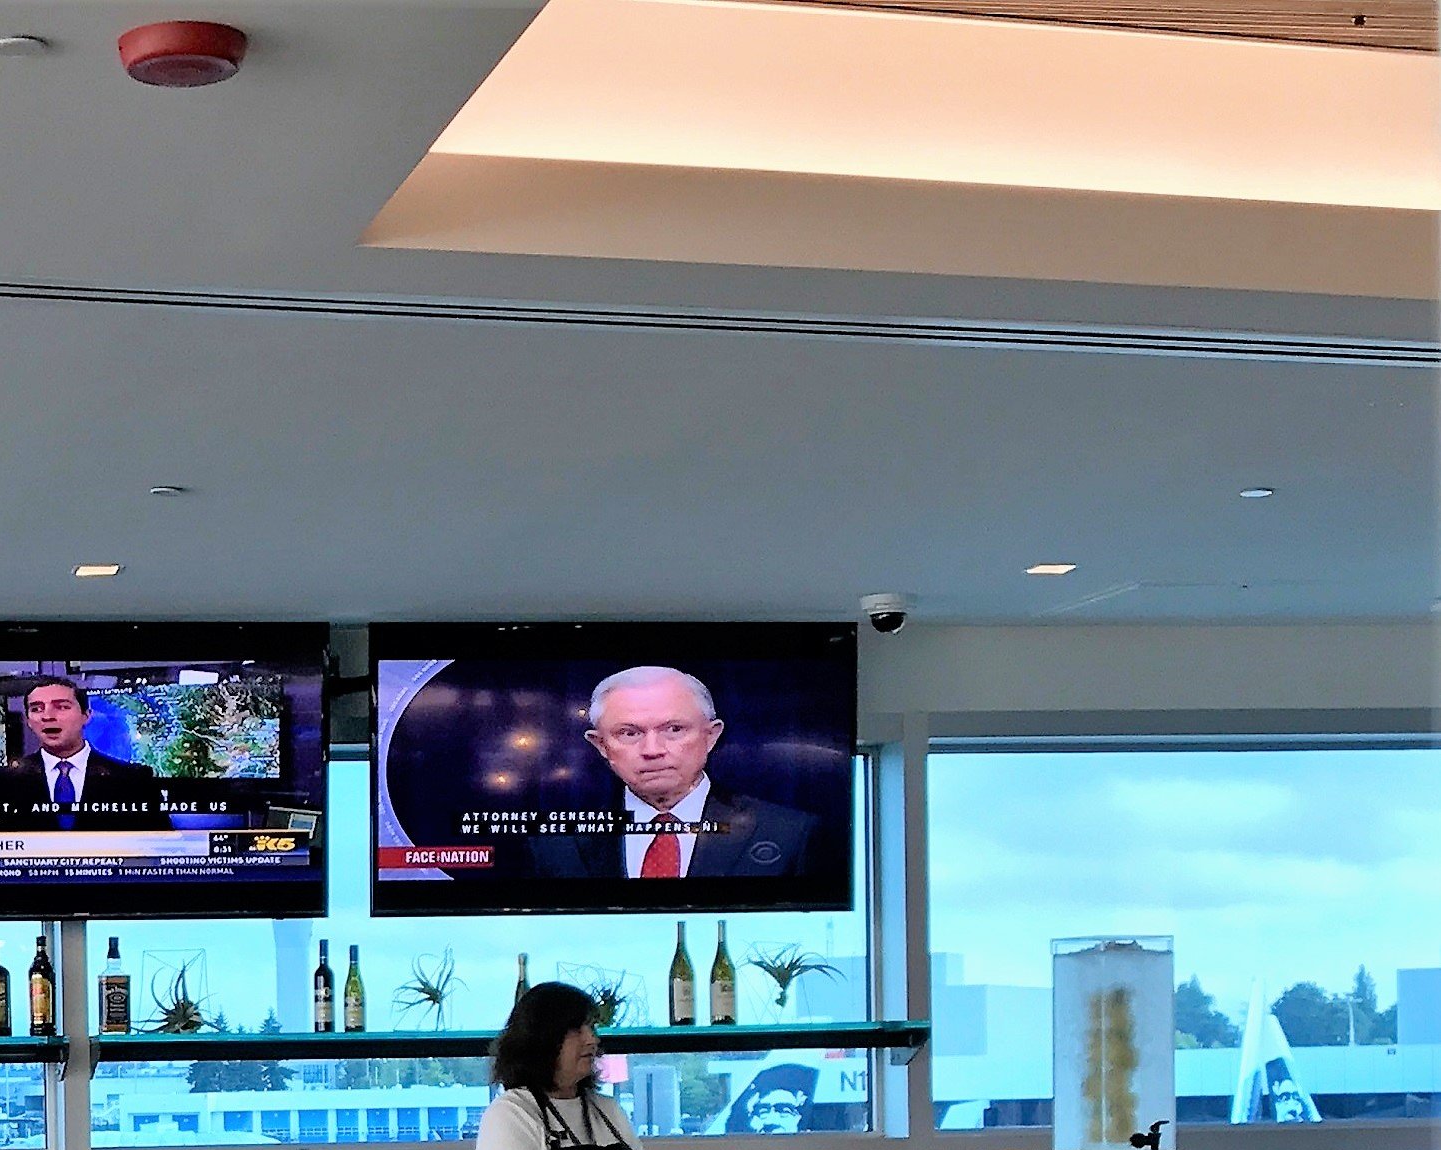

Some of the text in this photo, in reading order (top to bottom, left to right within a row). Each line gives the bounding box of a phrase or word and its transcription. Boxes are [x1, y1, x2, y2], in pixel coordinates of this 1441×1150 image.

[32, 802, 60, 812] AND
[71, 802, 149, 812] MICHELLE
[159, 802, 198, 811] MADE
[209, 801, 227, 811] US
[462, 811, 538, 822] ATTORNEY
[461, 824, 480, 834] WE
[490, 824, 528, 834] WILL
[539, 823, 567, 833] SEE
[577, 823, 614, 833] WHAT
[3, 858, 59, 866] SANCTUARY
[60, 858, 81, 866] CITY
[160, 857, 207, 865] SHOOTING
[405, 851, 436, 863] FACE
[440, 851, 490, 863] NATION
[199, 867, 234, 875] NORMAL
